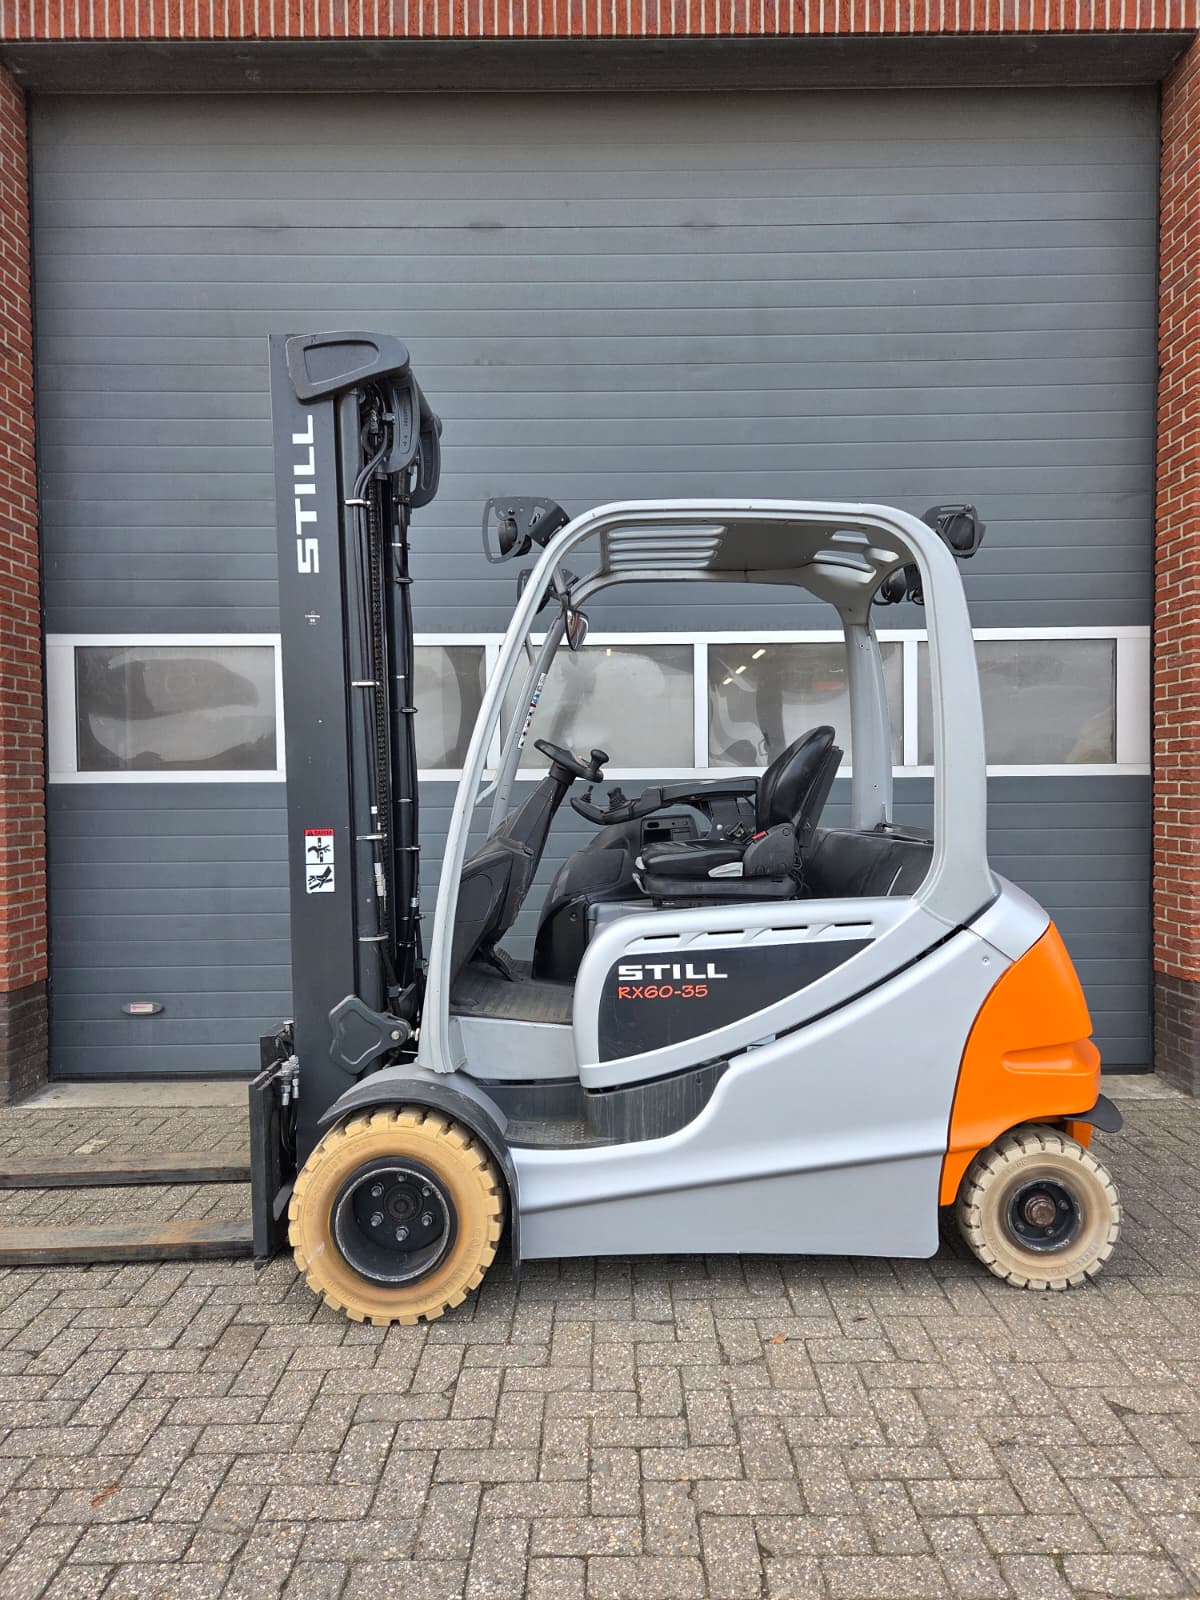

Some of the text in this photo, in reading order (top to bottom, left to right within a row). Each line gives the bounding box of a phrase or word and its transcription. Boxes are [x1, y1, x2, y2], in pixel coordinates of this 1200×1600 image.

[292, 414, 320, 574] STILL
[619, 963, 728, 981] STILL
[618, 985, 708, 999] RX60-35
